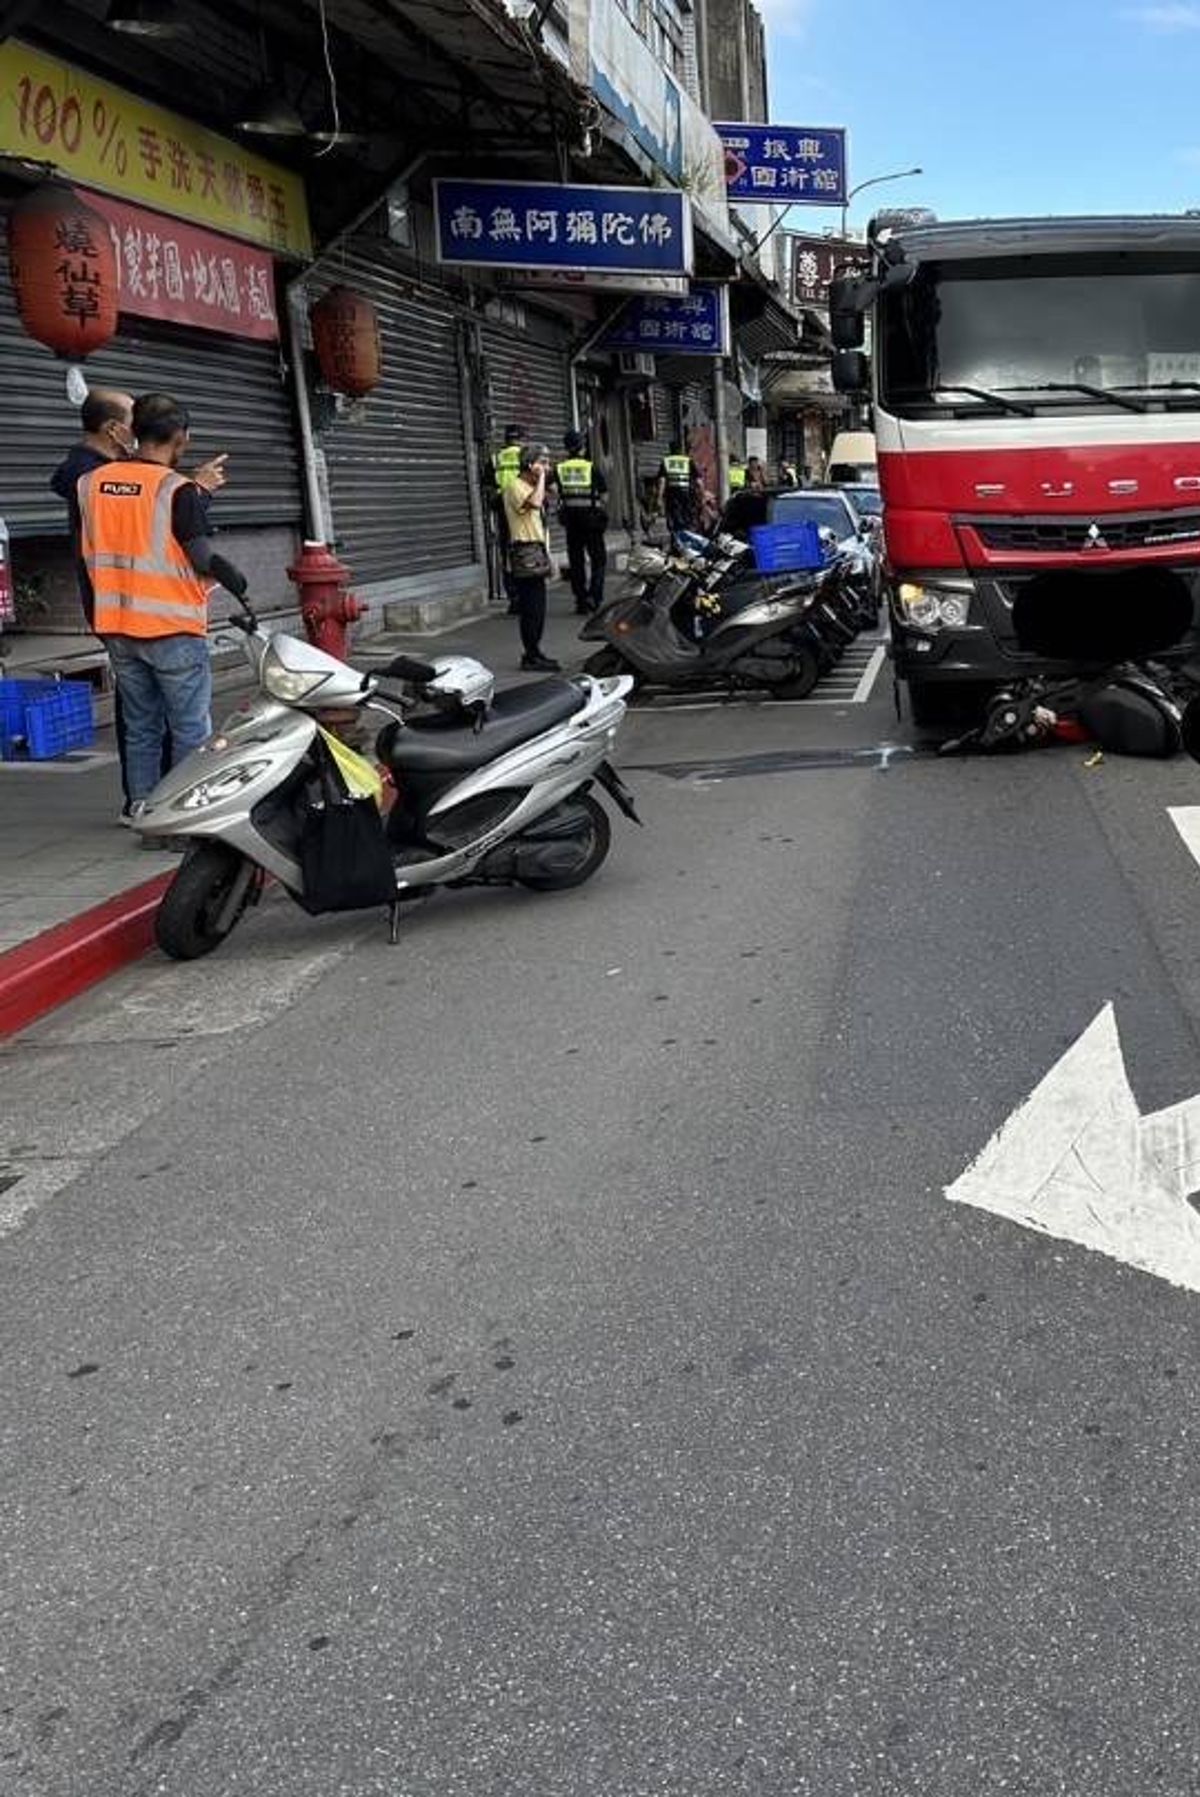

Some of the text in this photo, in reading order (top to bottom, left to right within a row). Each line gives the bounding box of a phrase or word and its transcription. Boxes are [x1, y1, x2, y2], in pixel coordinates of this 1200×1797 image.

[763, 137, 824, 163] 振興
[750, 166, 838, 192] 國術館
[450, 205, 673, 247] 南無阿彌陀佛
[54, 214, 100, 329] 燒仙草
